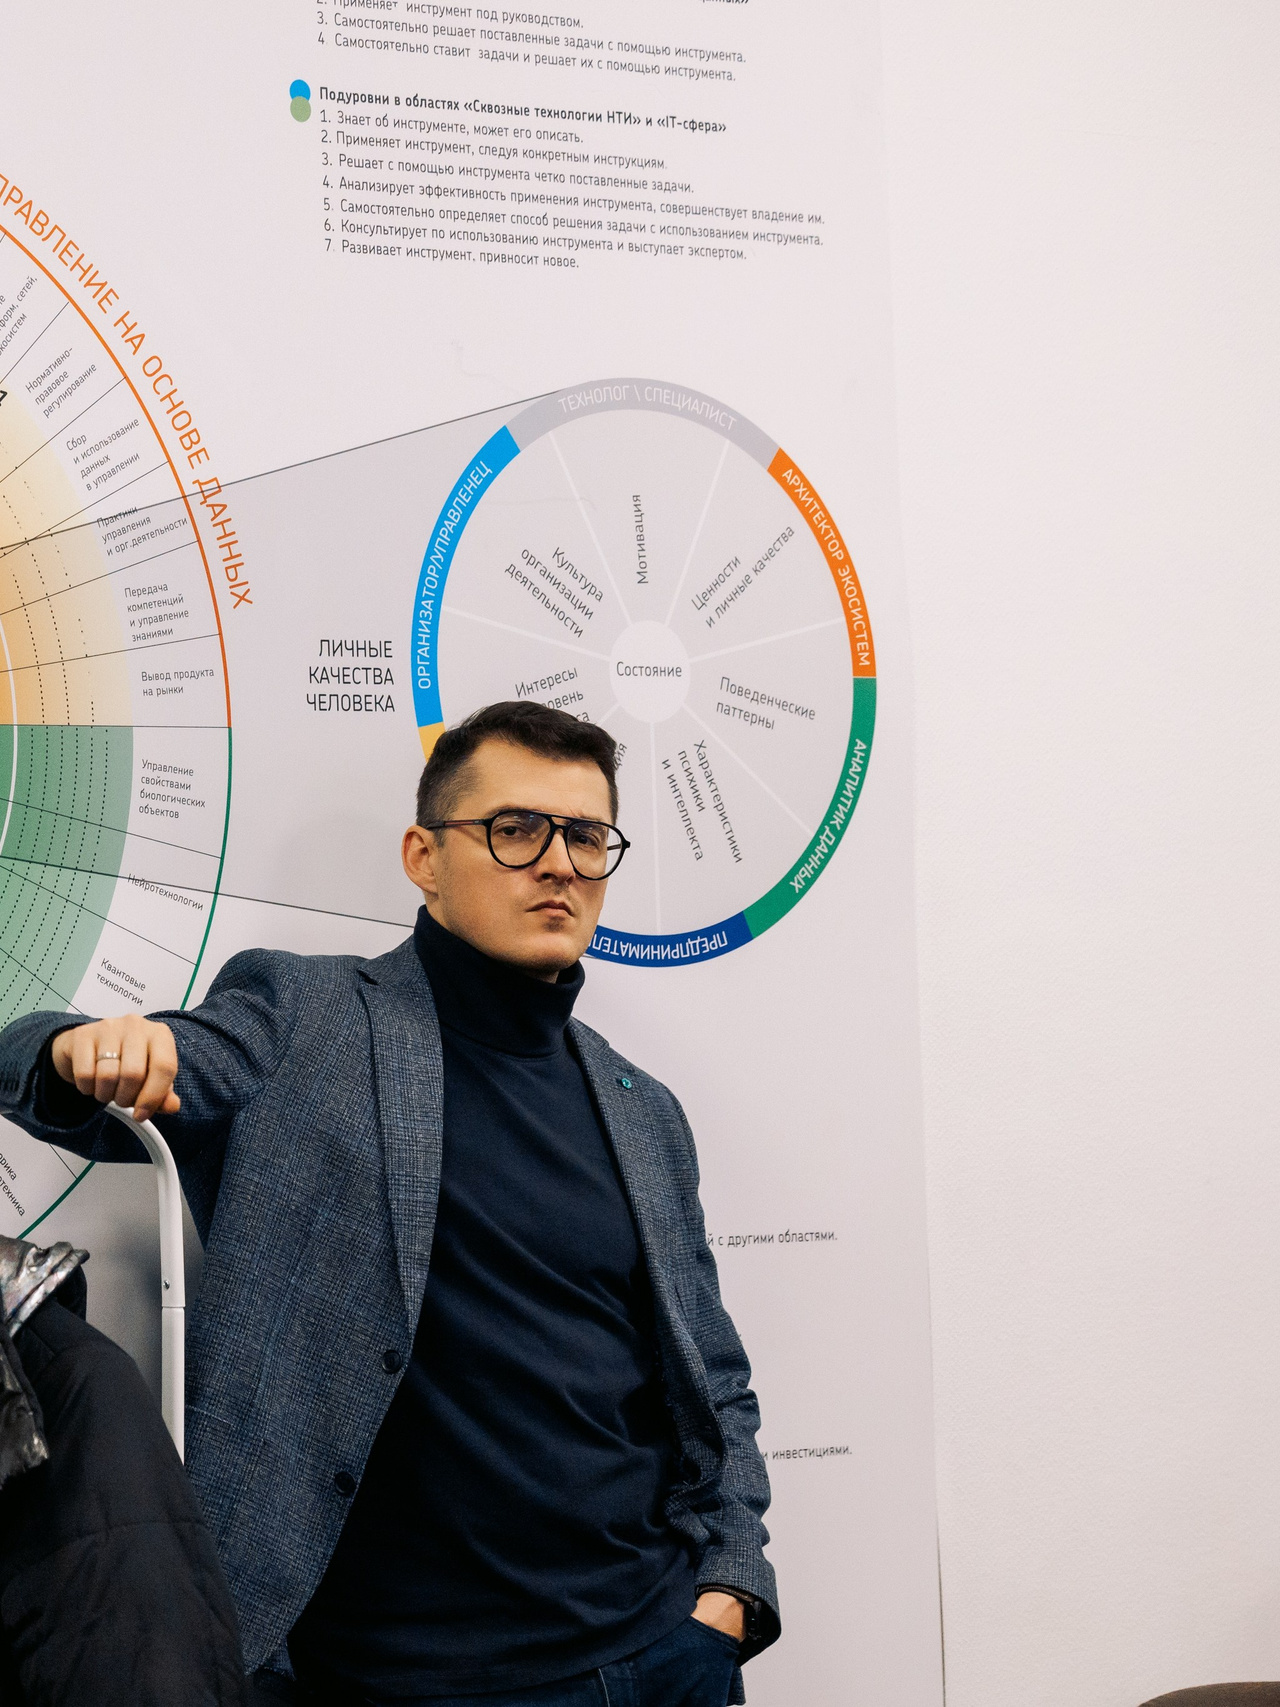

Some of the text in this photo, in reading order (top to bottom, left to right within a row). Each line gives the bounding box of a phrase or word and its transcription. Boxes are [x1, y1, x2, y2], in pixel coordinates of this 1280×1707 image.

[319, 86, 726, 134] Подуровни в областях «Сквозные технологии НТИ» и «IT-сфера»
[320, 109, 583, 143] 1. Знает об инструменте, может его описать.
[321, 129, 332, 143] 2.
[336, 130, 401, 148] Применяет
[405, 139, 474, 156] инструмент,
[478, 145, 518, 160] следуя
[522, 149, 589, 163] конкретным
[321, 151, 694, 193] 3. Решает с помощью инструмента четко поставленные задачи.
[322, 174, 824, 224] 4. Анализирует эффективность применения инструмента, совершенствует владение им.
[341, 239, 402, 256] Развивает
[479, 252, 539, 265] привносит
[543, 256, 579, 268] новое.
[16, 277, 38, 302] сетей,
[25, 347, 73, 393] Нормативно-
[43, 364, 97, 419] регулирование
[558, 386, 629, 413] ТЕХНОЛОГ
[645, 387, 736, 430] СПЕЦИАЛИСТ
[114, 311, 150, 354] НА
[143, 355, 210, 469] ОСНОВЕ
[193, 477, 253, 609] ДАННЫХ
[97, 507, 137, 528] Практики
[101, 516, 151, 545] управления
[632, 494, 649, 584] Мотивация
[418, 460, 493, 689] ОРГАНИЗАТОР/УПРАВЛЕНЕЦ
[521, 549, 594, 620] организации
[552, 546, 603, 602] Культура
[691, 556, 741, 611] Ценности
[705, 526, 795, 628] и личные качества
[781, 468, 870, 667] АРХИТЕКТОР ЭКОСИСТЕМ
[124, 583, 168, 598] Передача
[127, 593, 184, 612] компетенций
[504, 563, 583, 638] деятельности
[131, 628, 173, 642] знаниями
[319, 639, 393, 658] ЛИЧНЫЕ
[141, 669, 214, 682] Вывод продукта
[309, 666, 394, 685] КАЧЕСТВА
[515, 667, 578, 698] Интересы
[616, 661, 682, 677] Состояние
[306, 693, 395, 712] ЧЕЛОВЕКА
[719, 676, 816, 720] Поведенческие
[716, 702, 775, 730] паттерны
[140, 775, 191, 791] свойствами
[141, 758, 194, 777] Управление
[677, 750, 705, 812] психики
[138, 803, 179, 819] объектов
[139, 788, 205, 808] биологических
[693, 739, 742, 863] Характеристики
[789, 739, 867, 893] АНАЛИТИК ДАННЫХ
[128, 873, 203, 910] Нейротехнологии
[588, 931, 728, 960] ПРЕДПРИНИМАТЕЛ
[96, 973, 143, 1006] технологии
[100, 957, 146, 991] Квантовые
[718, 1236, 723, 1246] с
[727, 1234, 774, 1248] другими
[778, 1229, 837, 1243] областями.
[772, 1446, 852, 1460] инвестициями.
